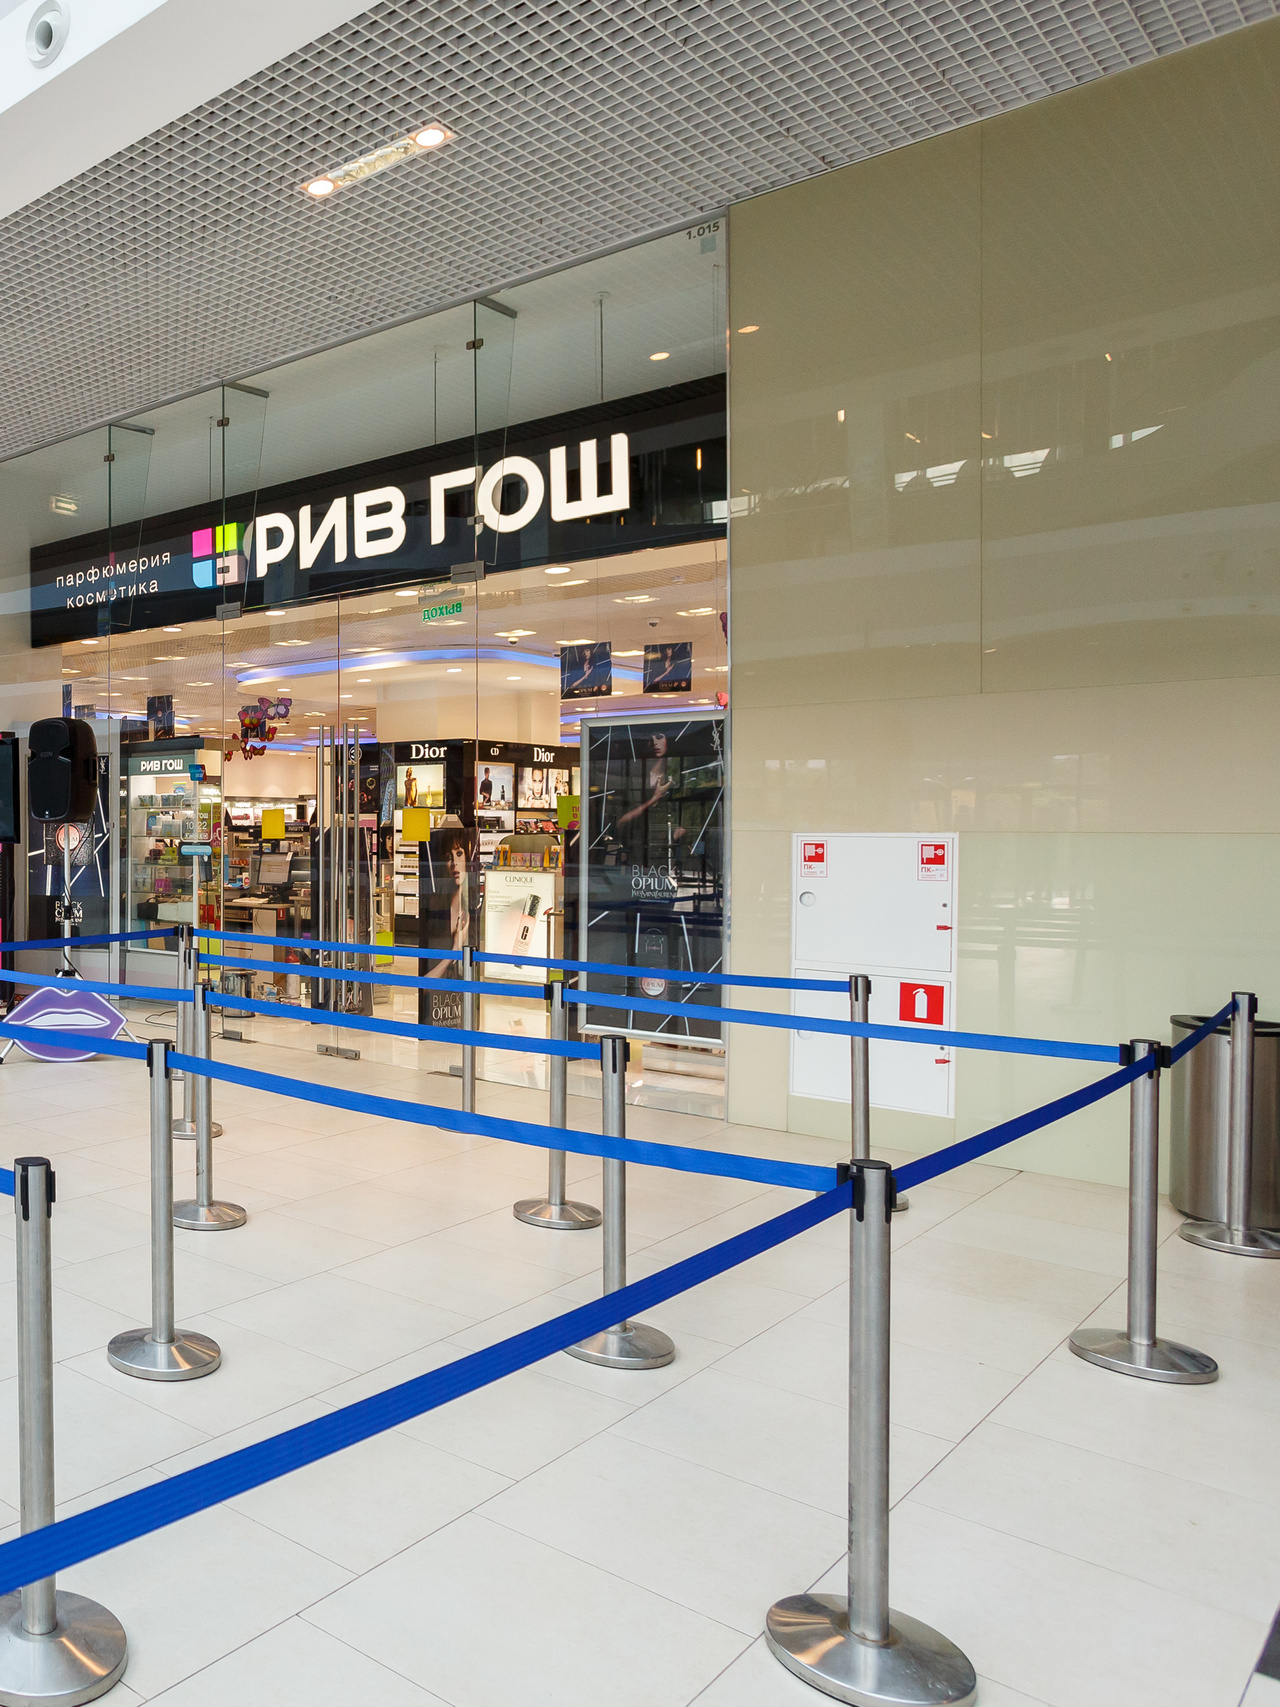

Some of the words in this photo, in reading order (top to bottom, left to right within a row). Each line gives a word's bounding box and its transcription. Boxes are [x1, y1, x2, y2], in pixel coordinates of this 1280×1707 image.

[686, 221, 720, 240] 1.015
[256, 485, 407, 578] РИВ
[430, 432, 630, 546] ГОШ
[56, 552, 171, 589] парфюмерия
[66, 579, 159, 609] косметика
[410, 743, 448, 759] Dior
[533, 747, 555, 763] Dior
[140, 760, 161, 772] РИВ
[162, 759, 183, 771] ГОШ
[632, 864, 678, 878] BLACK
[505, 875, 534, 884] CLINIQUE
[631, 877, 678, 891] OPIUM
[432, 992, 462, 1008] BLACK
[432, 1005, 462, 1020] OPIUM
